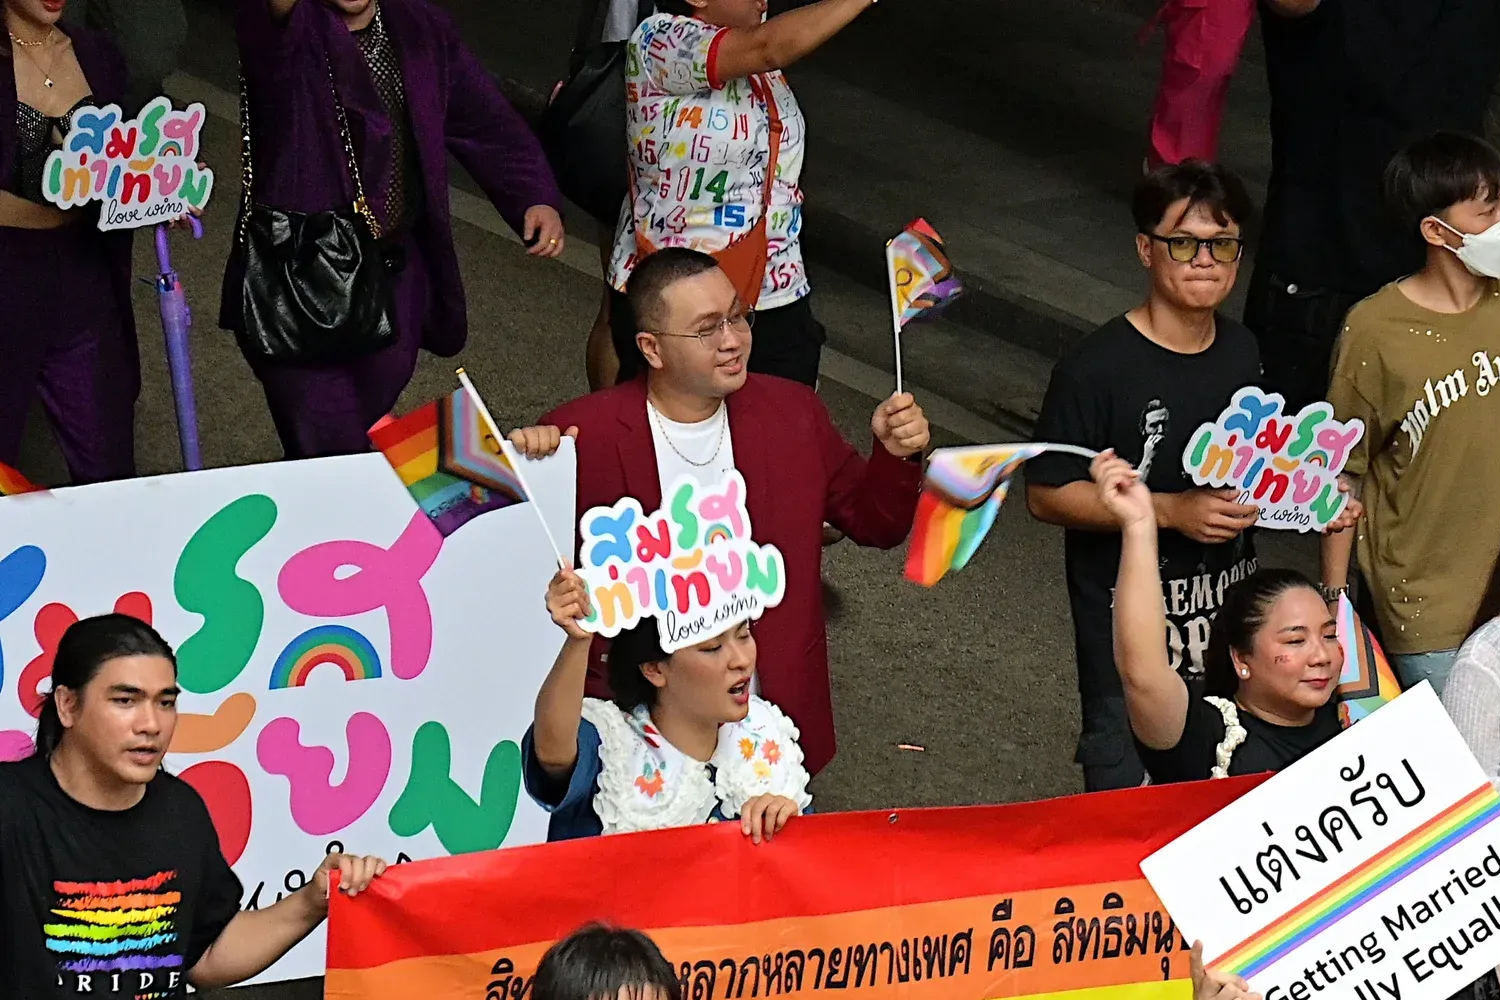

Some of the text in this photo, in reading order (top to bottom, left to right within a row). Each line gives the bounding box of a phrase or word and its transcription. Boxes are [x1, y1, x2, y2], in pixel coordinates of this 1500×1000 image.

[707, 107, 728, 130] 15
[49, 153, 207, 206] เท่าเทียม
[689, 167, 728, 203] 14
[105, 198, 182, 225] love wins
[713, 205, 746, 227] 15
[1190, 431, 1343, 524] เท่าเทียม
[1271, 506, 1310, 525] wins
[667, 596, 757, 644] love wins
[1220, 754, 1426, 914] แต่งครับ
[987, 898, 1036, 971] คือ
